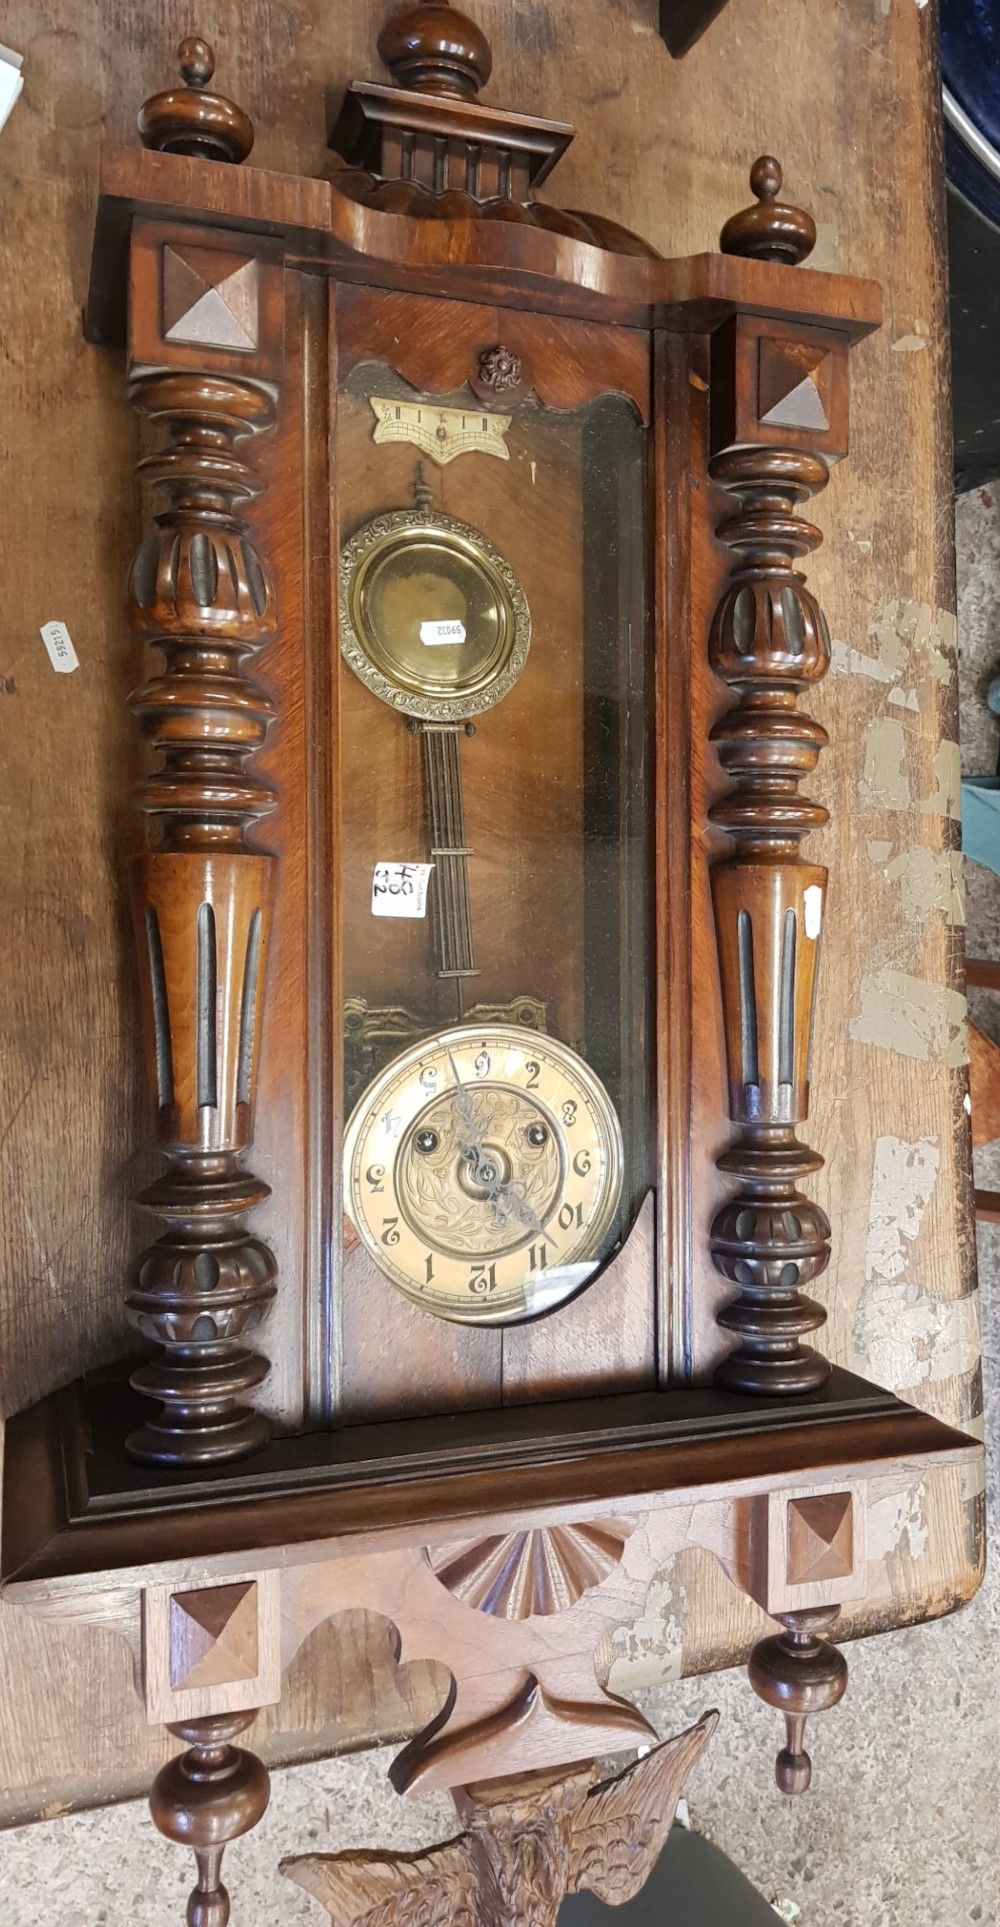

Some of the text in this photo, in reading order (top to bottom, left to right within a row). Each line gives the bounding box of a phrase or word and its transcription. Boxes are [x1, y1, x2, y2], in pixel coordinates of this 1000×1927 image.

[50, 629, 69, 658] 59215
[436, 625, 461, 635] 59032
[475, 1050, 491, 1079] 6
[525, 1061, 541, 1089] 7
[419, 1066, 438, 1097] 5
[381, 1108, 401, 1138] 4
[561, 1099, 578, 1127] 8
[572, 1149, 592, 1178] 9
[366, 1163, 386, 1194] 3
[558, 1201, 583, 1230] 10
[381, 1216, 400, 1246] 2
[424, 1252, 435, 1285] 1
[527, 1243, 548, 1273] 11
[468, 1262, 498, 1294] 12
